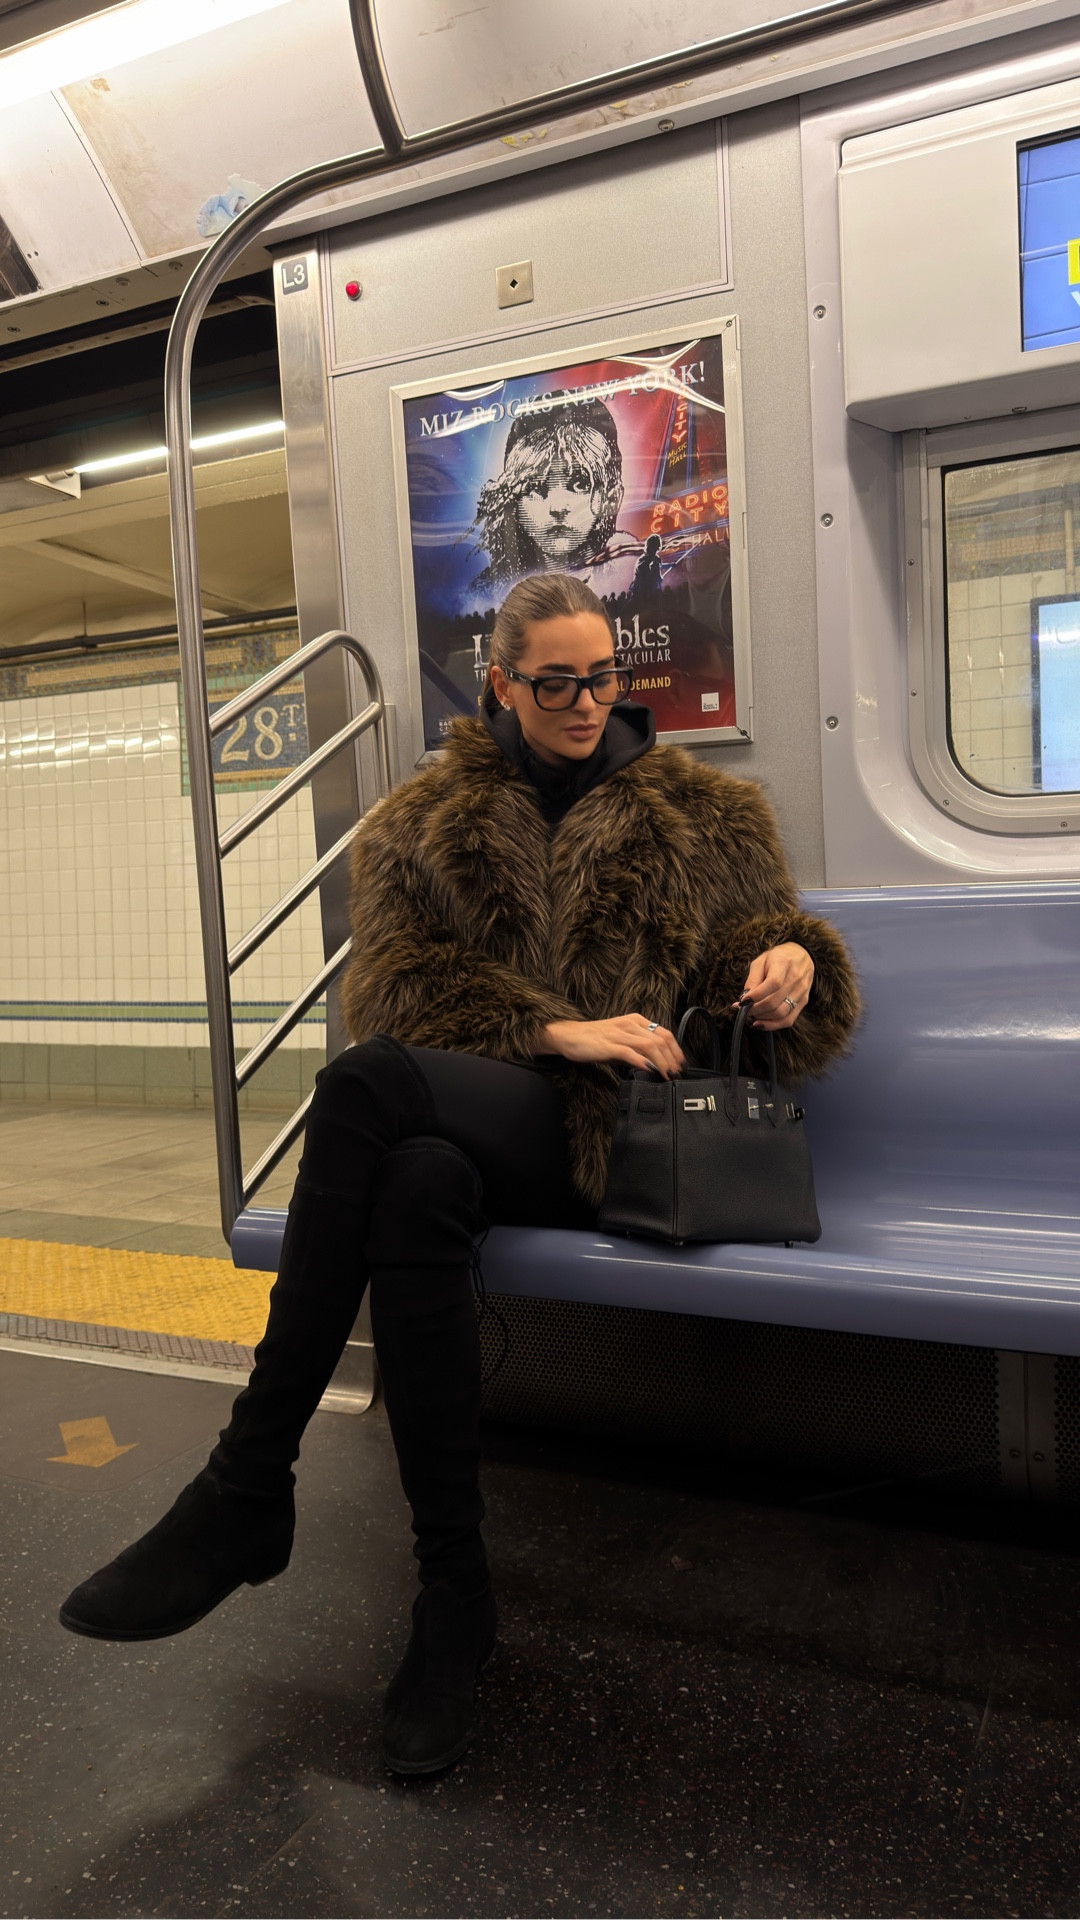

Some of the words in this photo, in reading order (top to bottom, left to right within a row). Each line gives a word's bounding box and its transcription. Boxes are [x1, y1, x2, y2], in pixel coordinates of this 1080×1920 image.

[282, 263, 306, 289] L3
[420, 409, 464, 437] MIZ
[471, 392, 553, 426] ROCKS
[562, 378, 620, 409] NEW
[624, 361, 705, 396] YORK!
[667, 441, 687, 460] MUSIC
[668, 451, 687, 468] HALL
[651, 500, 728, 533] CITY
[653, 485, 728, 518] RADIO
[220, 703, 307, 764] 28T
